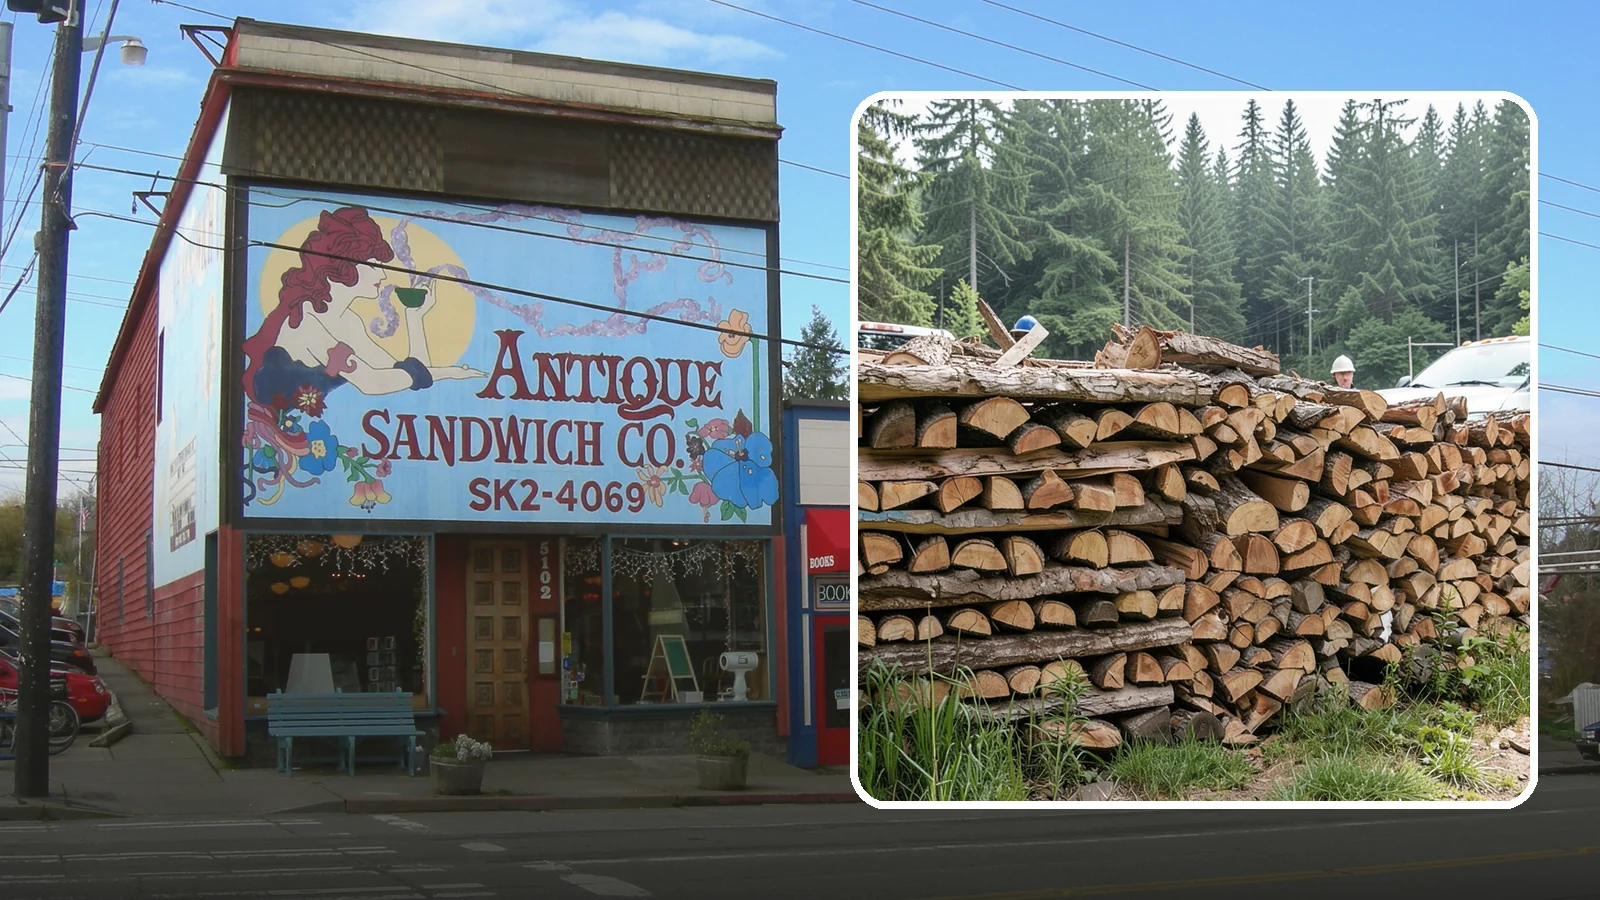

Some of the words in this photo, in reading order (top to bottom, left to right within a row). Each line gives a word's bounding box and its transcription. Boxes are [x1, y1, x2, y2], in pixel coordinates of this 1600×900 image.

[475, 329, 723, 420] ANTIQUE
[361, 409, 604, 467] SANDWICH
[617, 422, 685, 469] CO.
[469, 478, 646, 512] SK2-4069
[540, 541, 551, 599] 5102
[809, 555, 834, 569] BOOKS
